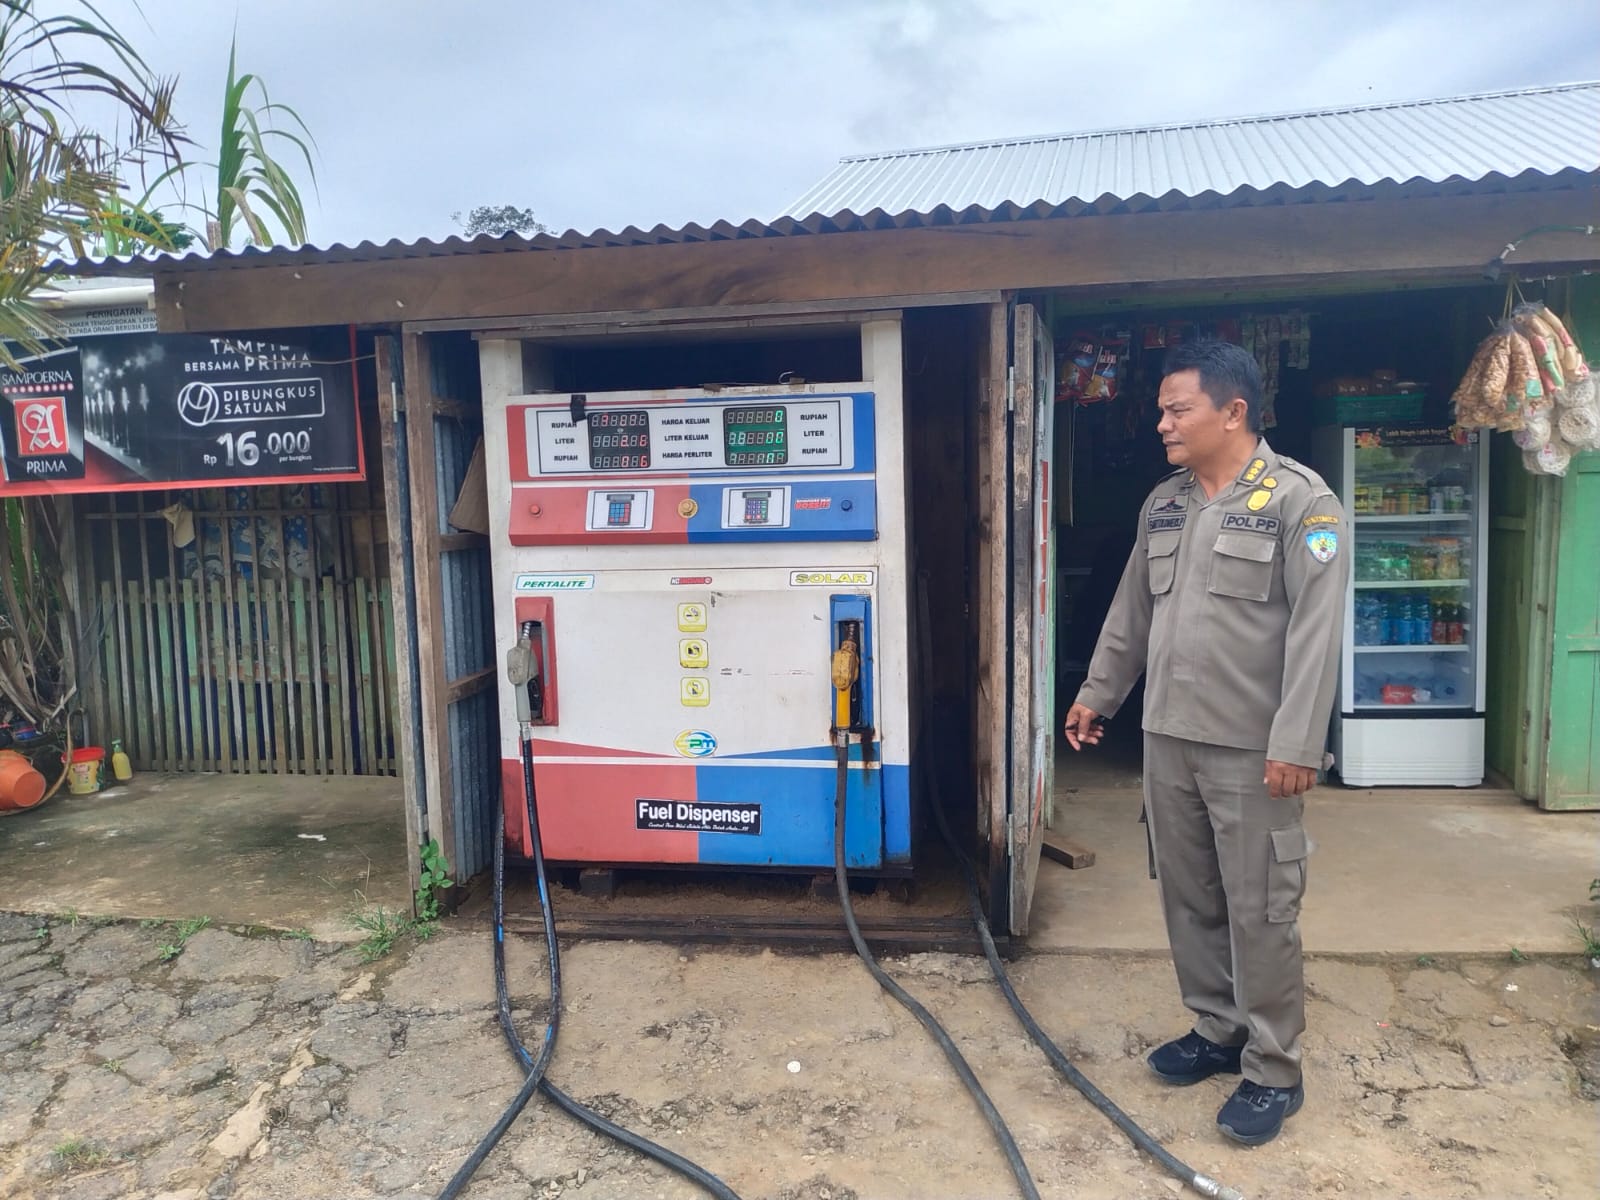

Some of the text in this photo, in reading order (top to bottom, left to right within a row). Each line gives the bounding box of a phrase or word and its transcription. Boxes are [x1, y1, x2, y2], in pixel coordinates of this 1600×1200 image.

[184, 352, 312, 372] BERSAMA PRIMA
[2, 370, 73, 386] SAMPOERNA
[223, 386, 316, 402] DIBUNGKUS
[224, 401, 286, 415] SATUAN
[661, 417, 710, 426] HARGA KELUAR
[684, 433, 710, 441] KELUAR
[203, 454, 217, 467] Rp
[553, 454, 579, 462] RUPIAH
[662, 451, 683, 459] HARGA
[26, 460, 67, 474] PRIMA
[1226, 516, 1277, 532] POL PP
[522, 579, 587, 588] PERTALITE
[794, 573, 868, 584] SOLAR
[639, 802, 759, 825] Fuel Dispenser
